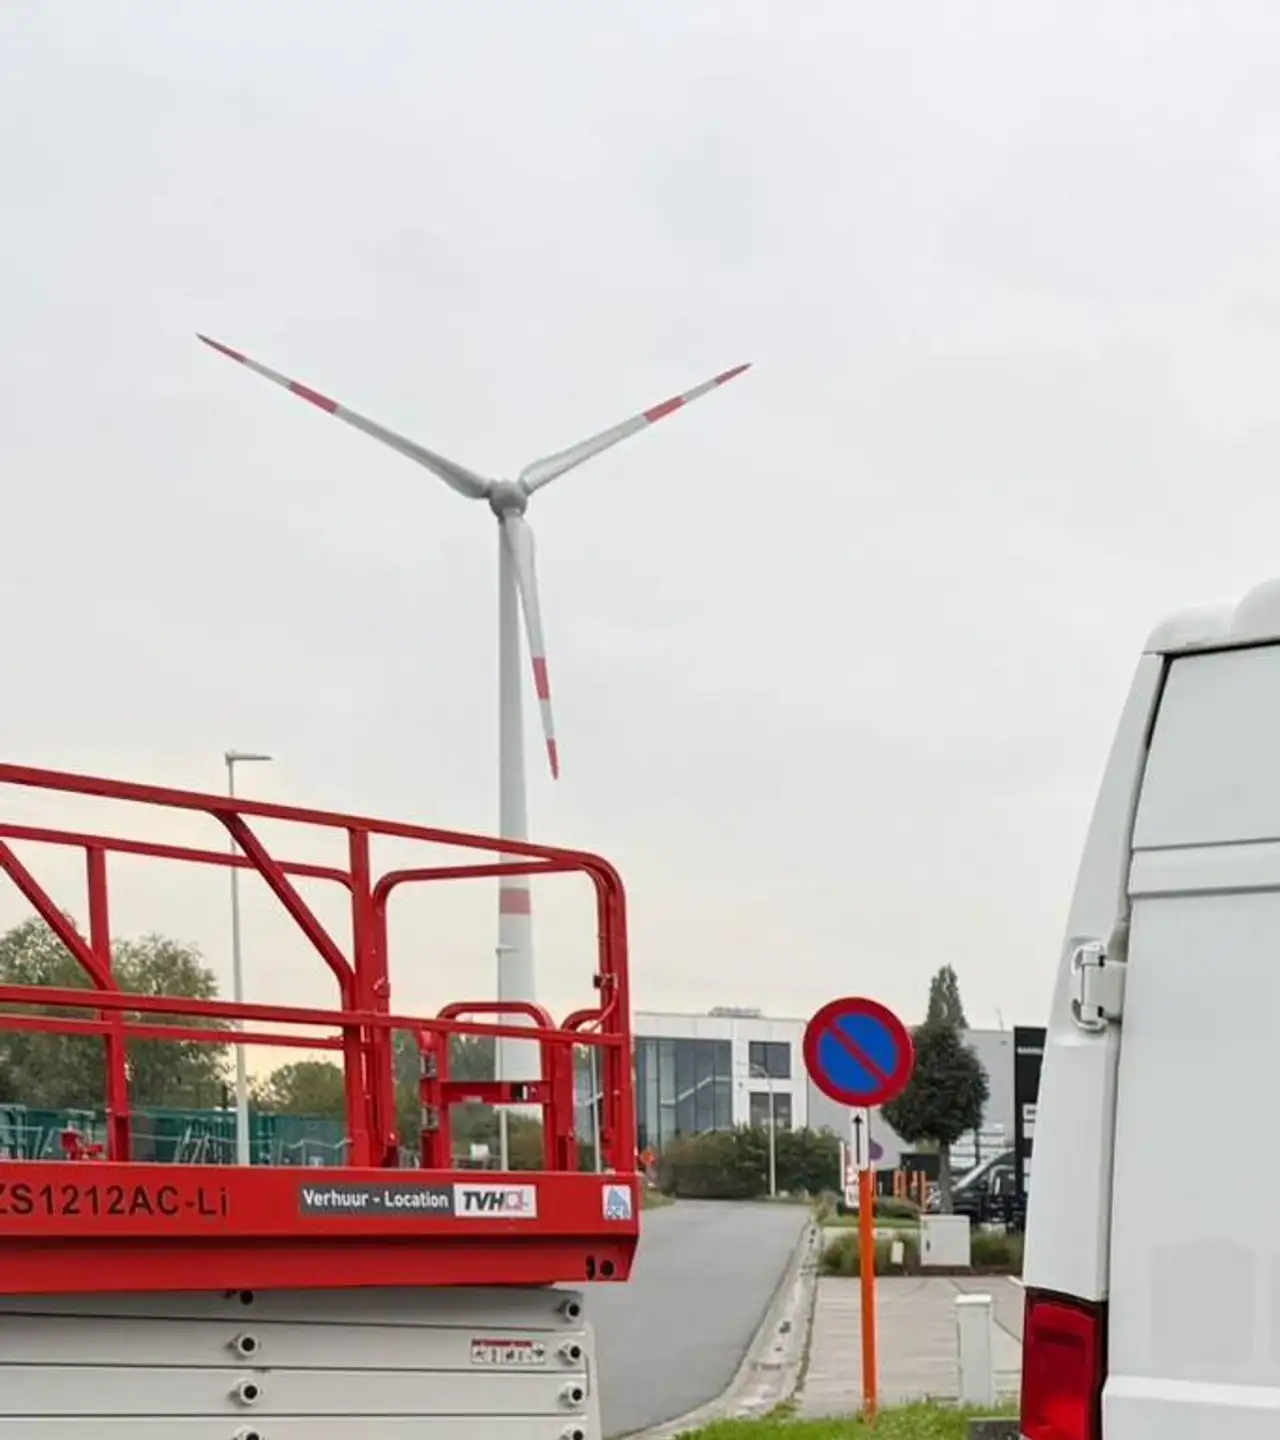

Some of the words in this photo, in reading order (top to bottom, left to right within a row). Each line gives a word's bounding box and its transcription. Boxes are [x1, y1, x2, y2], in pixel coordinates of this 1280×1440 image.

[302, 1188, 369, 1207] Verhuur
[384, 1190, 449, 1210] Location
[462, 1190, 504, 1211] TVH
